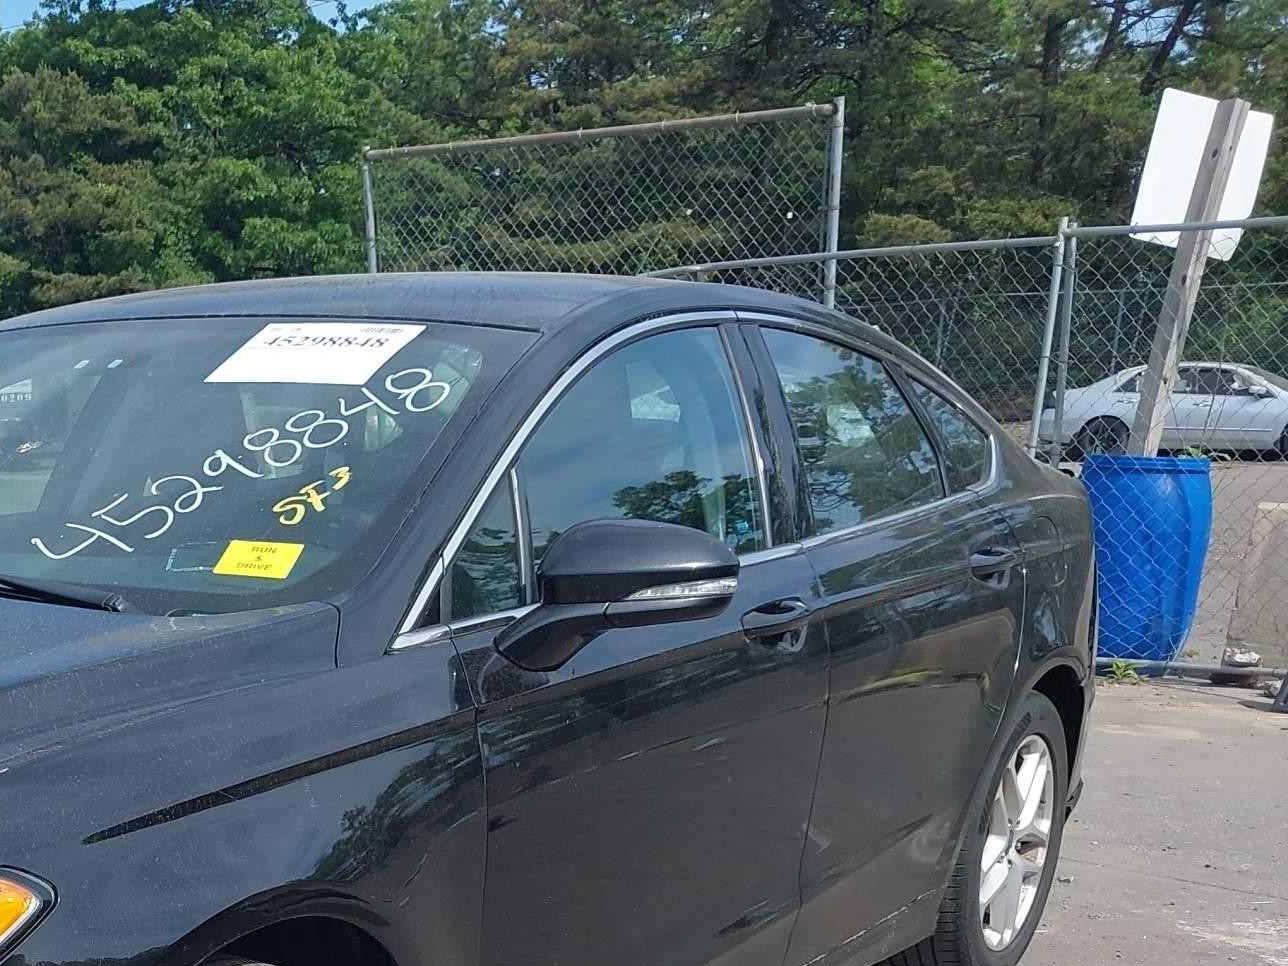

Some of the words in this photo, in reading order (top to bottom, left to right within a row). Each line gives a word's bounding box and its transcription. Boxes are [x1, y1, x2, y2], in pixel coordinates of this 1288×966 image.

[262, 334, 390, 349] 45298848
[30, 367, 452, 560] 45298848
[250, 546, 278, 554] RUN
[235, 562, 273, 571] DRIVE
